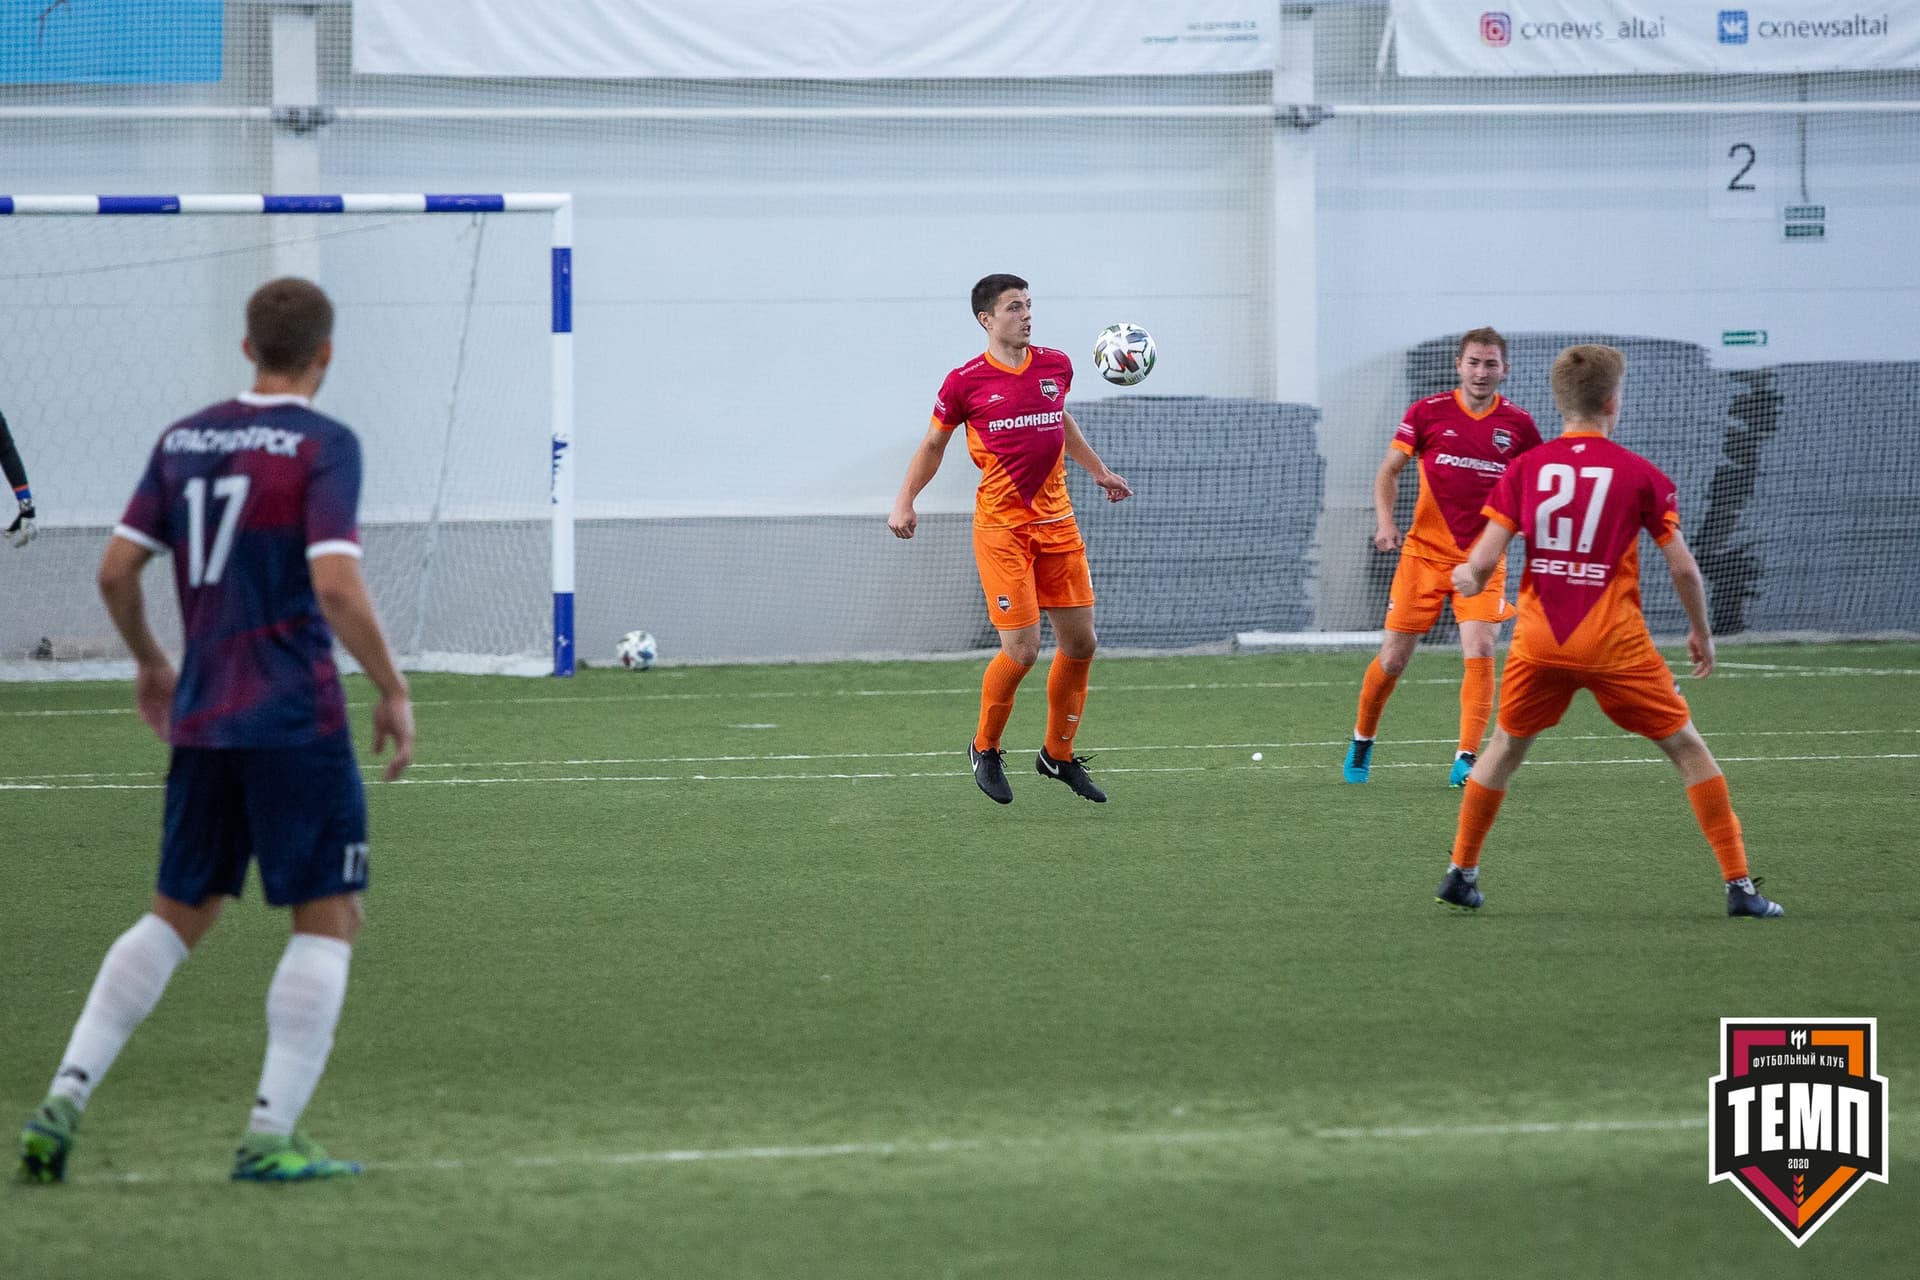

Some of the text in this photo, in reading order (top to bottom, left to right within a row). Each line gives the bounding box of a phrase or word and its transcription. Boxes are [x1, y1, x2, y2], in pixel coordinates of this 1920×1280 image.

[1520, 15, 1666, 42] cxnews_altai
[1757, 13, 1889, 39] cxnewsaltai
[1727, 142, 1756, 191] 2
[1535, 462, 1614, 554] 27
[182, 474, 250, 589] 17
[1530, 558, 1609, 580] SEUS
